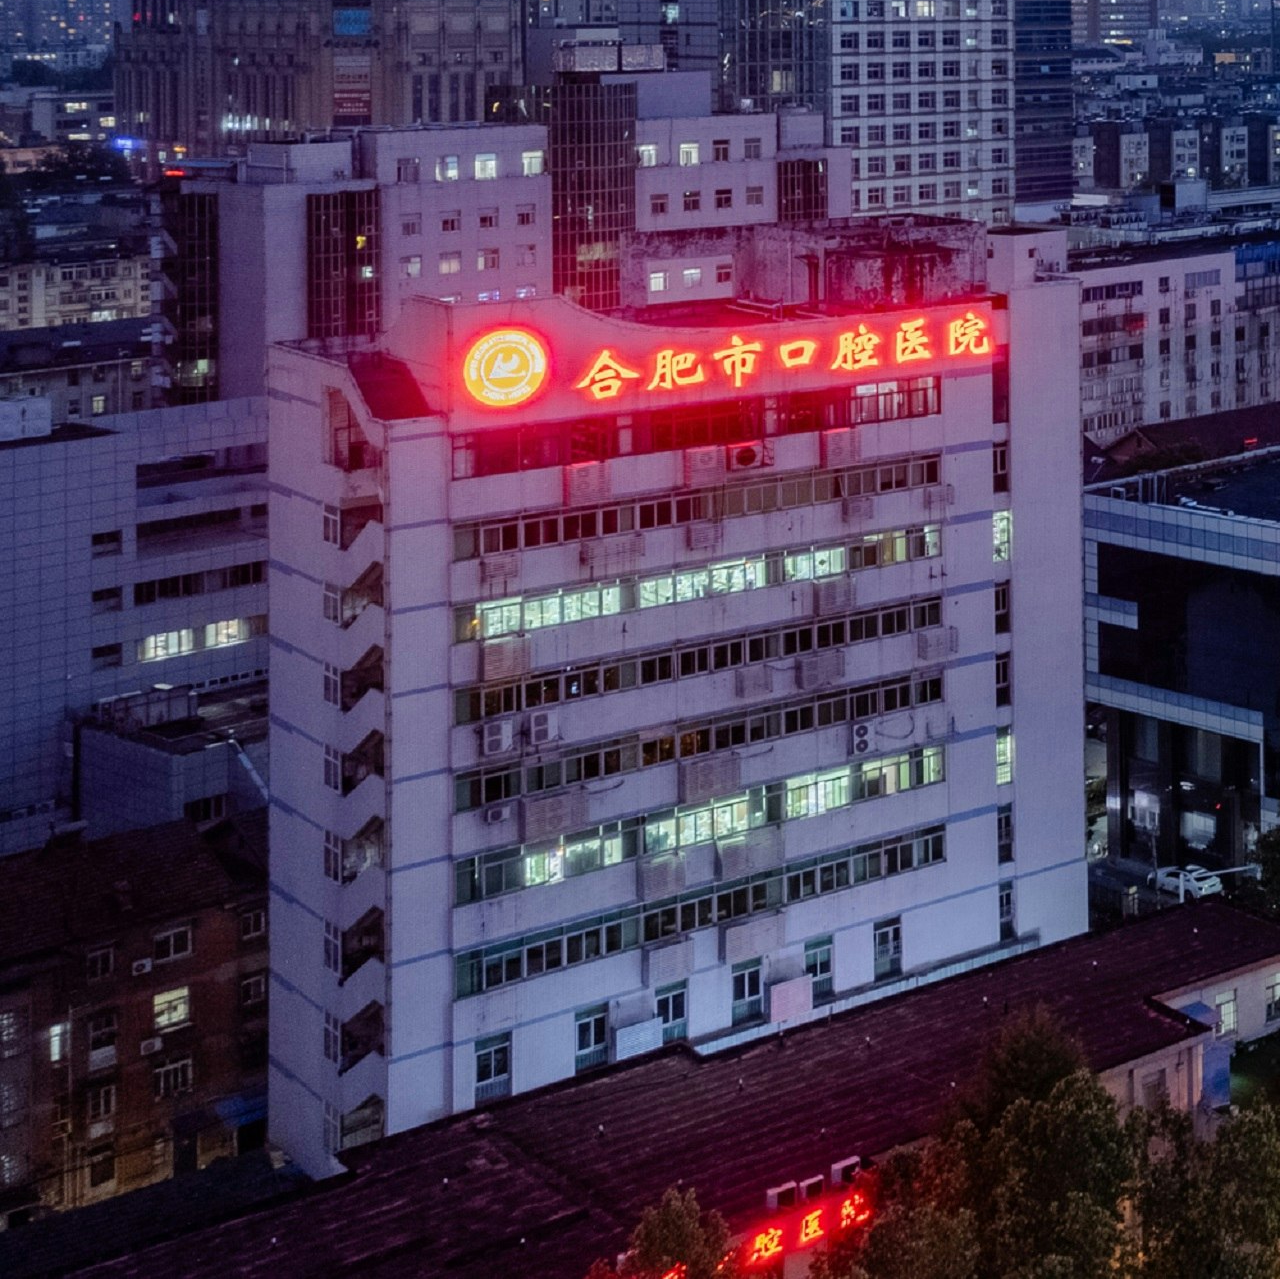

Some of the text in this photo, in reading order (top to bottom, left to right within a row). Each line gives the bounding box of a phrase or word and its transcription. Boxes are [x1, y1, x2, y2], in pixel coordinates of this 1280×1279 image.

[576, 312, 993, 399] 合肥市口腔医院
